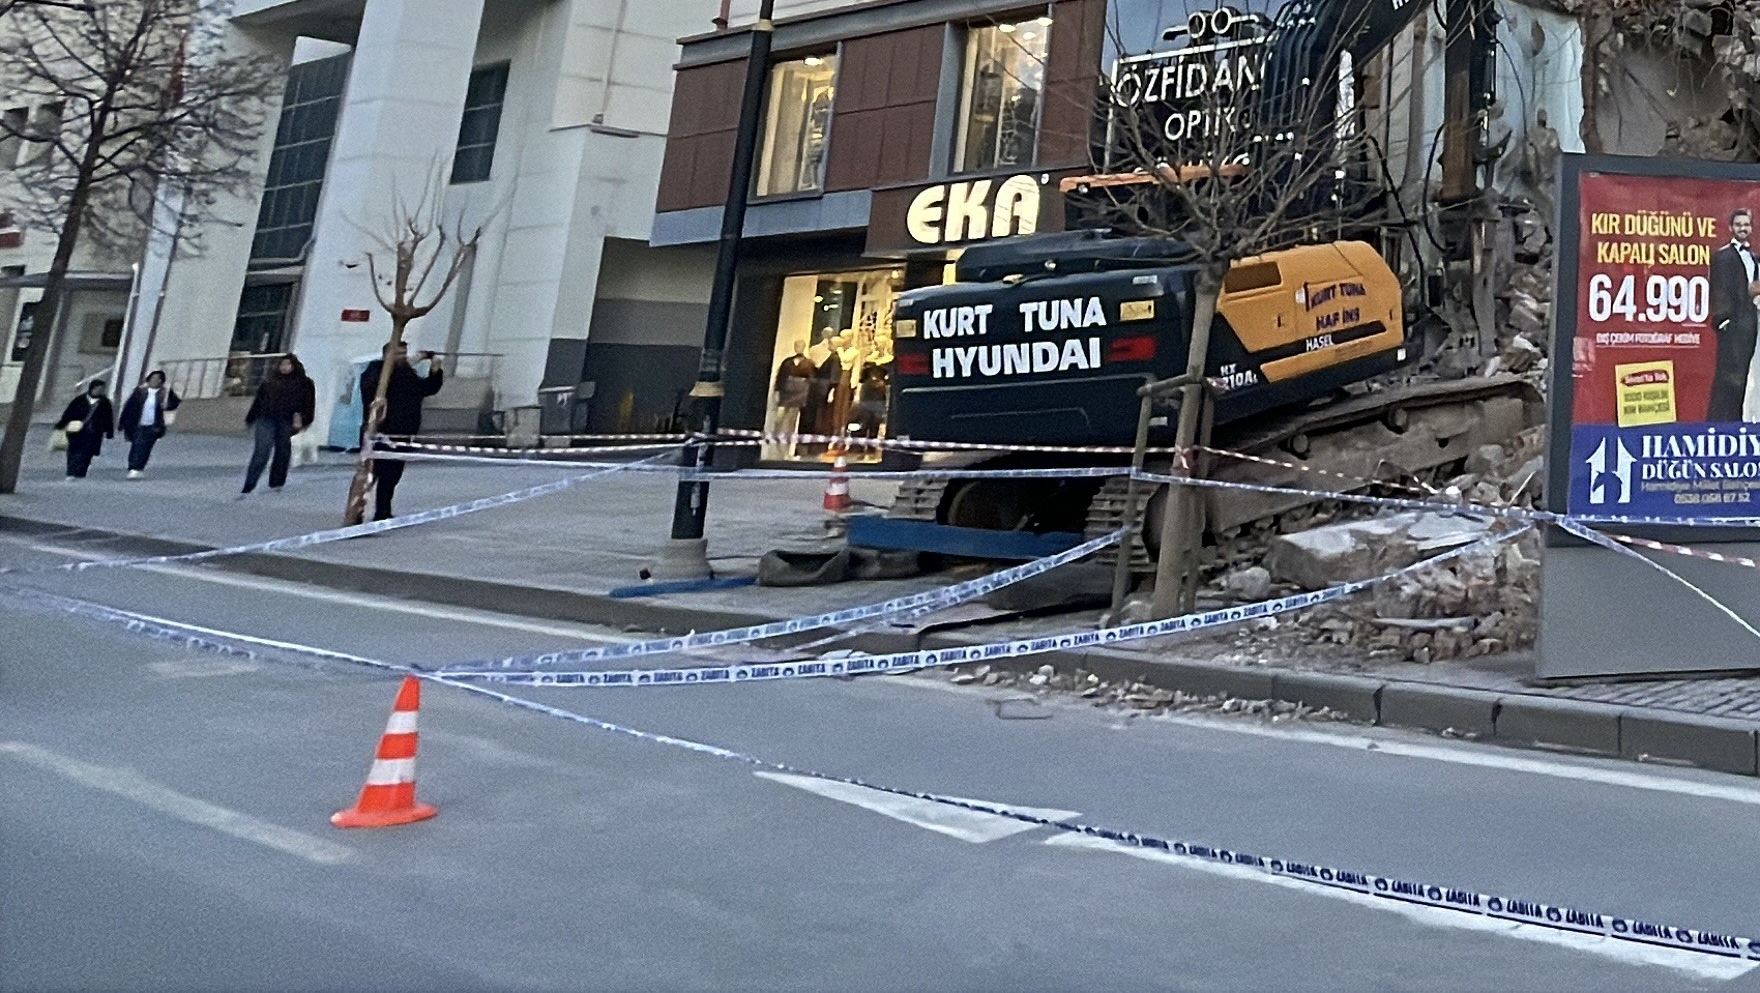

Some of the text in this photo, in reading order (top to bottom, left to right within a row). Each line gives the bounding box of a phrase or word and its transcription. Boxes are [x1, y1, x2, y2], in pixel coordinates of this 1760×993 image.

[907, 174, 1040, 244] EKA
[1591, 209, 1717, 238] KIR DÜĞÜNÜ VE
[1597, 241, 1711, 265] KAPALI SALON
[1589, 274, 1709, 322] 64.990
[923, 297, 1107, 339] KURT TUNA
[932, 337, 1101, 378] HYUNDAI
[1305, 334, 1334, 352] HASEL
[1642, 459, 1706, 480] DÜĞÜN
[1074, 633, 1100, 645] ZABITA
